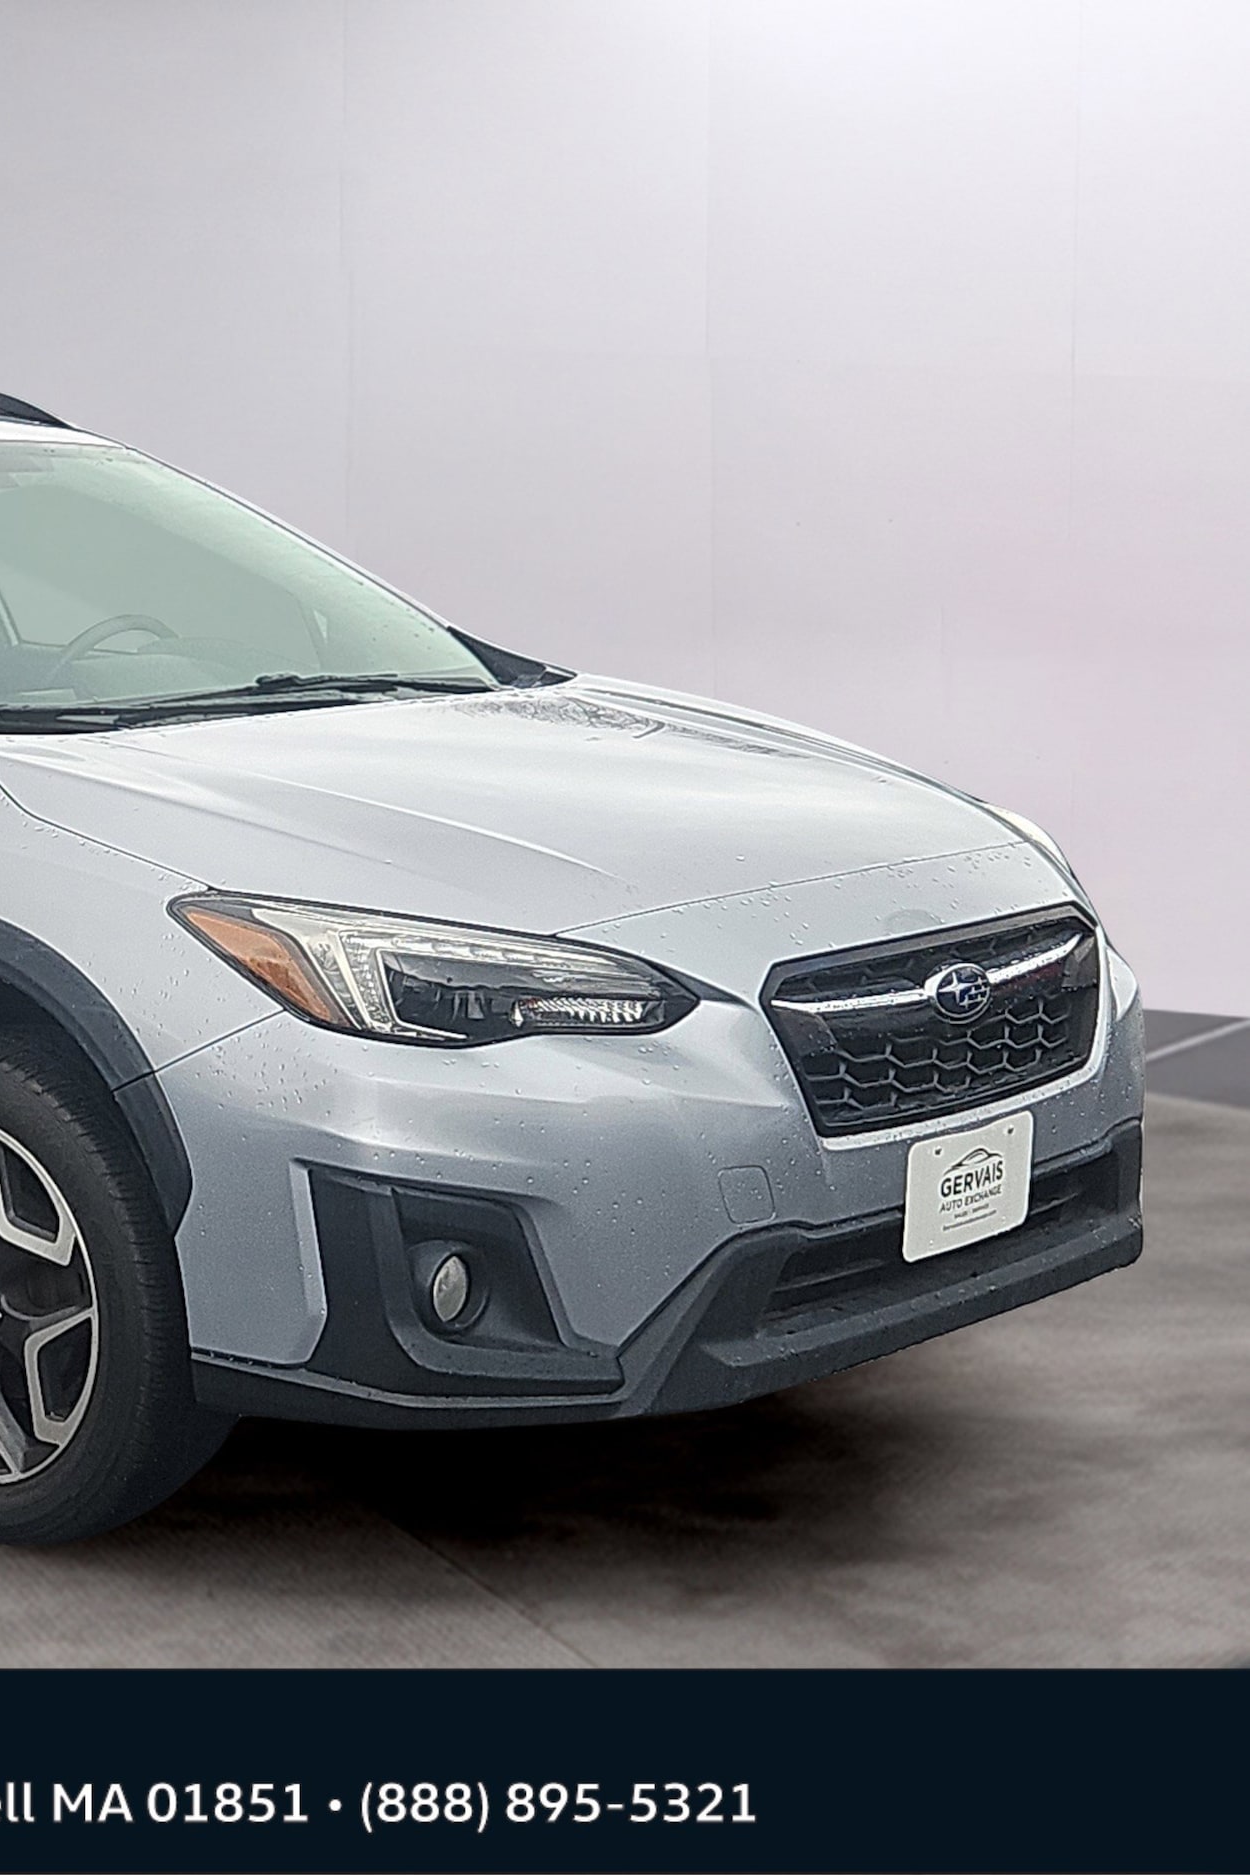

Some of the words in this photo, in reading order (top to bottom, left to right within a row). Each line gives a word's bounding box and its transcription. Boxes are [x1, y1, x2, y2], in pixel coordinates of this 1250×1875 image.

[941, 1160, 1003, 1197] GERVAIS
[940, 1199, 962, 1213] AUTO
[965, 1184, 1002, 1205] EXCHANGE
